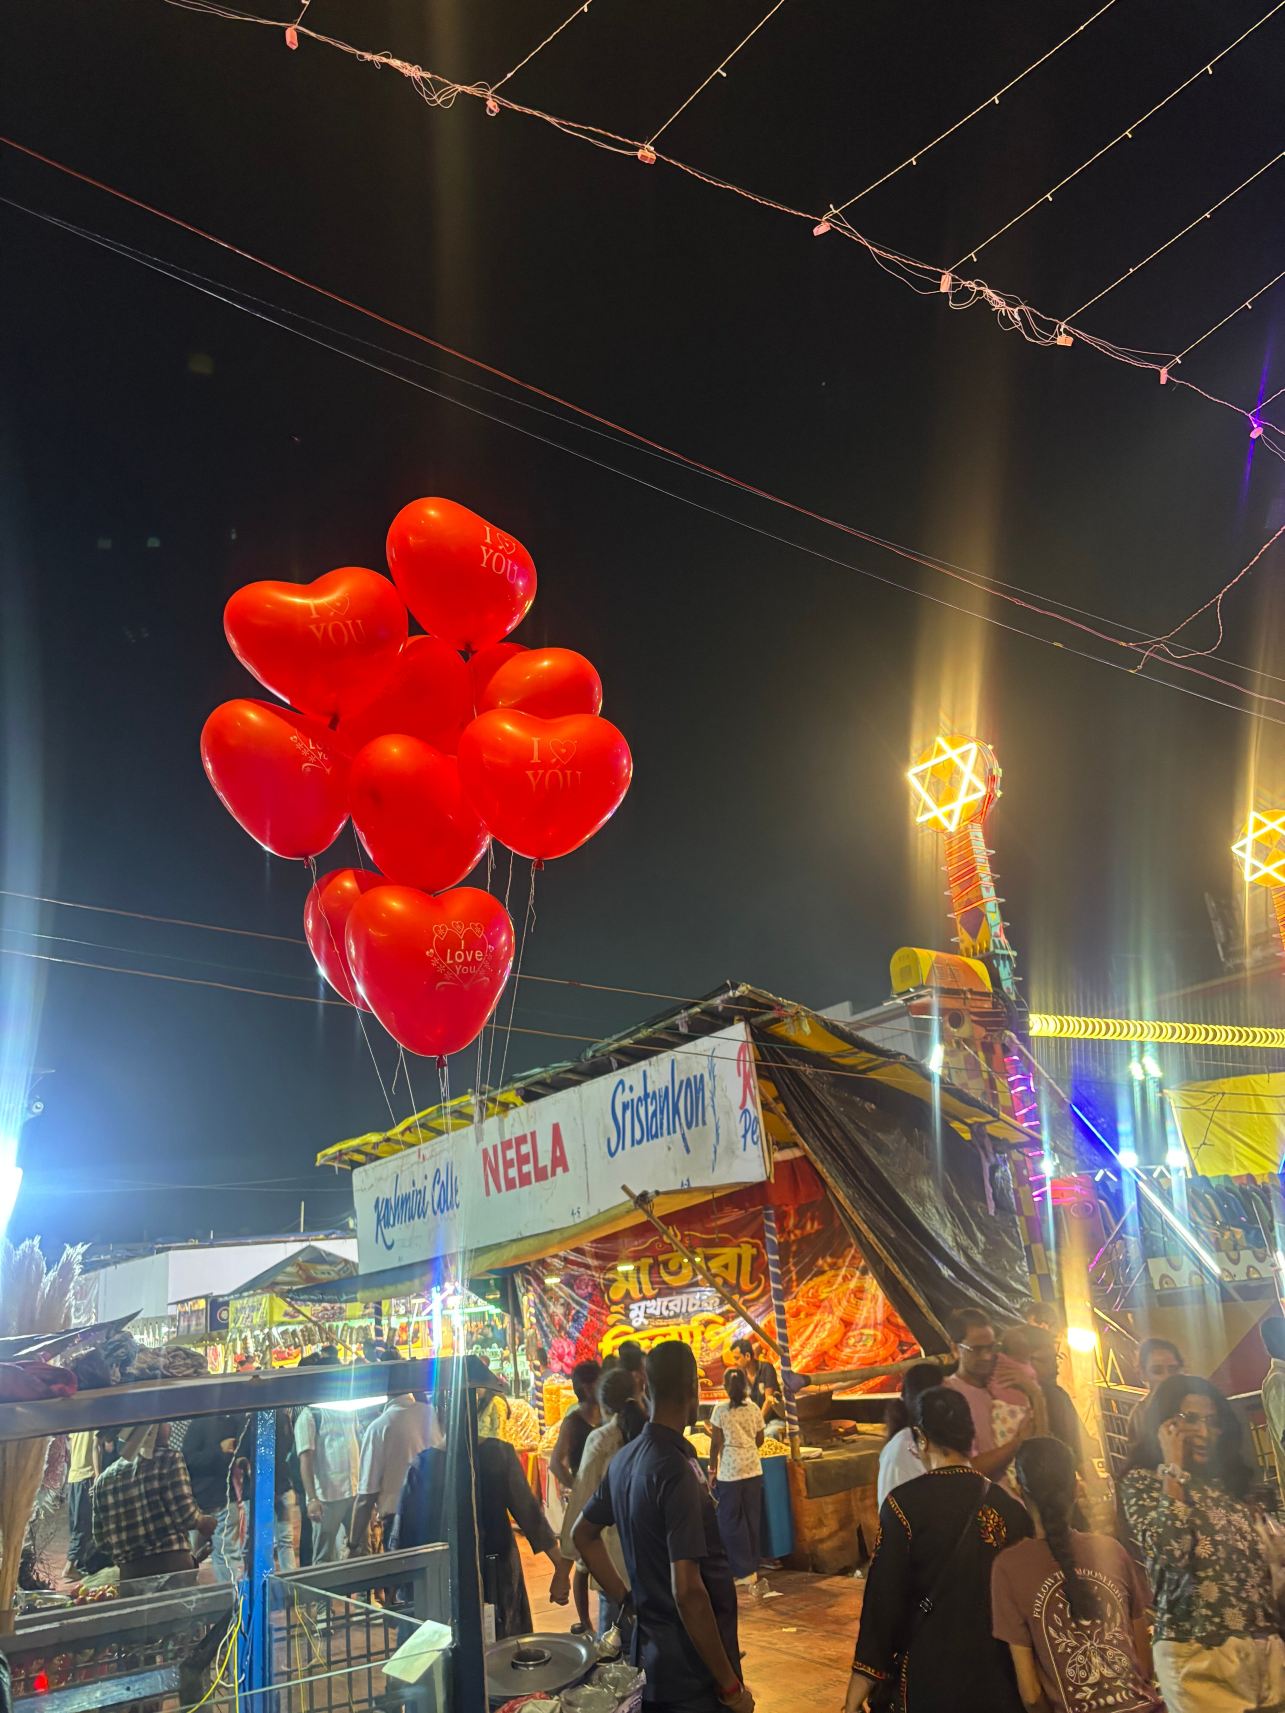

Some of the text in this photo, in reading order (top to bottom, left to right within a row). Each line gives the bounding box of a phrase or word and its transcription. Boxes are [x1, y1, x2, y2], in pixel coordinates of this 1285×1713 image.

[484, 525, 492, 545] I
[480, 545, 519, 585] YOU
[309, 619, 366, 646] YOU
[530, 736, 542, 763] I
[525, 769, 583, 792] YOU
[446, 949, 484, 965] Love
[454, 964, 477, 976] You
[606, 1057, 707, 1159] Sristankon
[482, 1121, 570, 1198] NEELA
